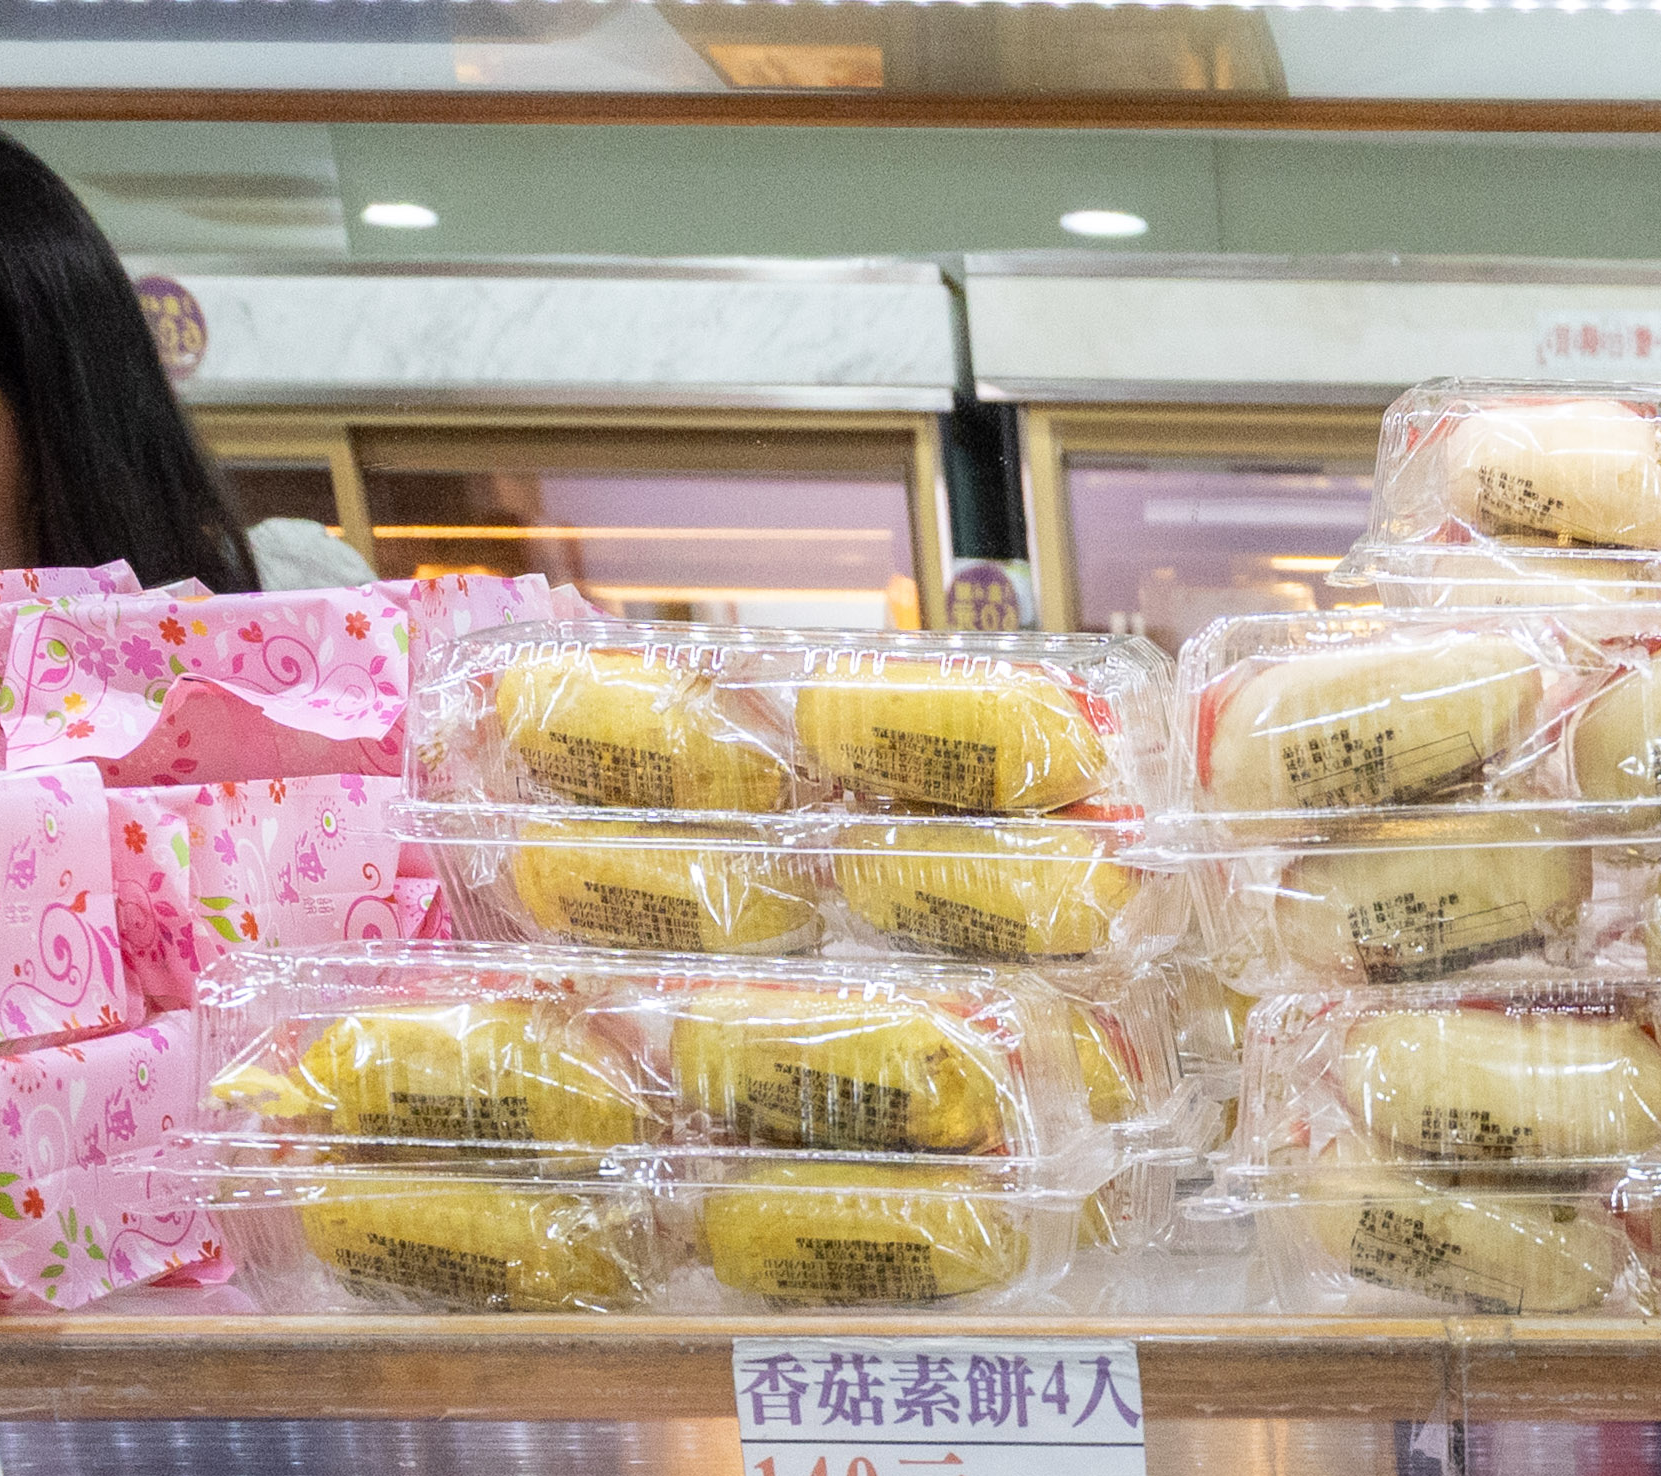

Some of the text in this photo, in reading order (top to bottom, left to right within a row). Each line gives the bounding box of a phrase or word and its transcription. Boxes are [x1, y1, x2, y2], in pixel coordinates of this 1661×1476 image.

[740, 1352, 1141, 1429] 香菇素餅4入
